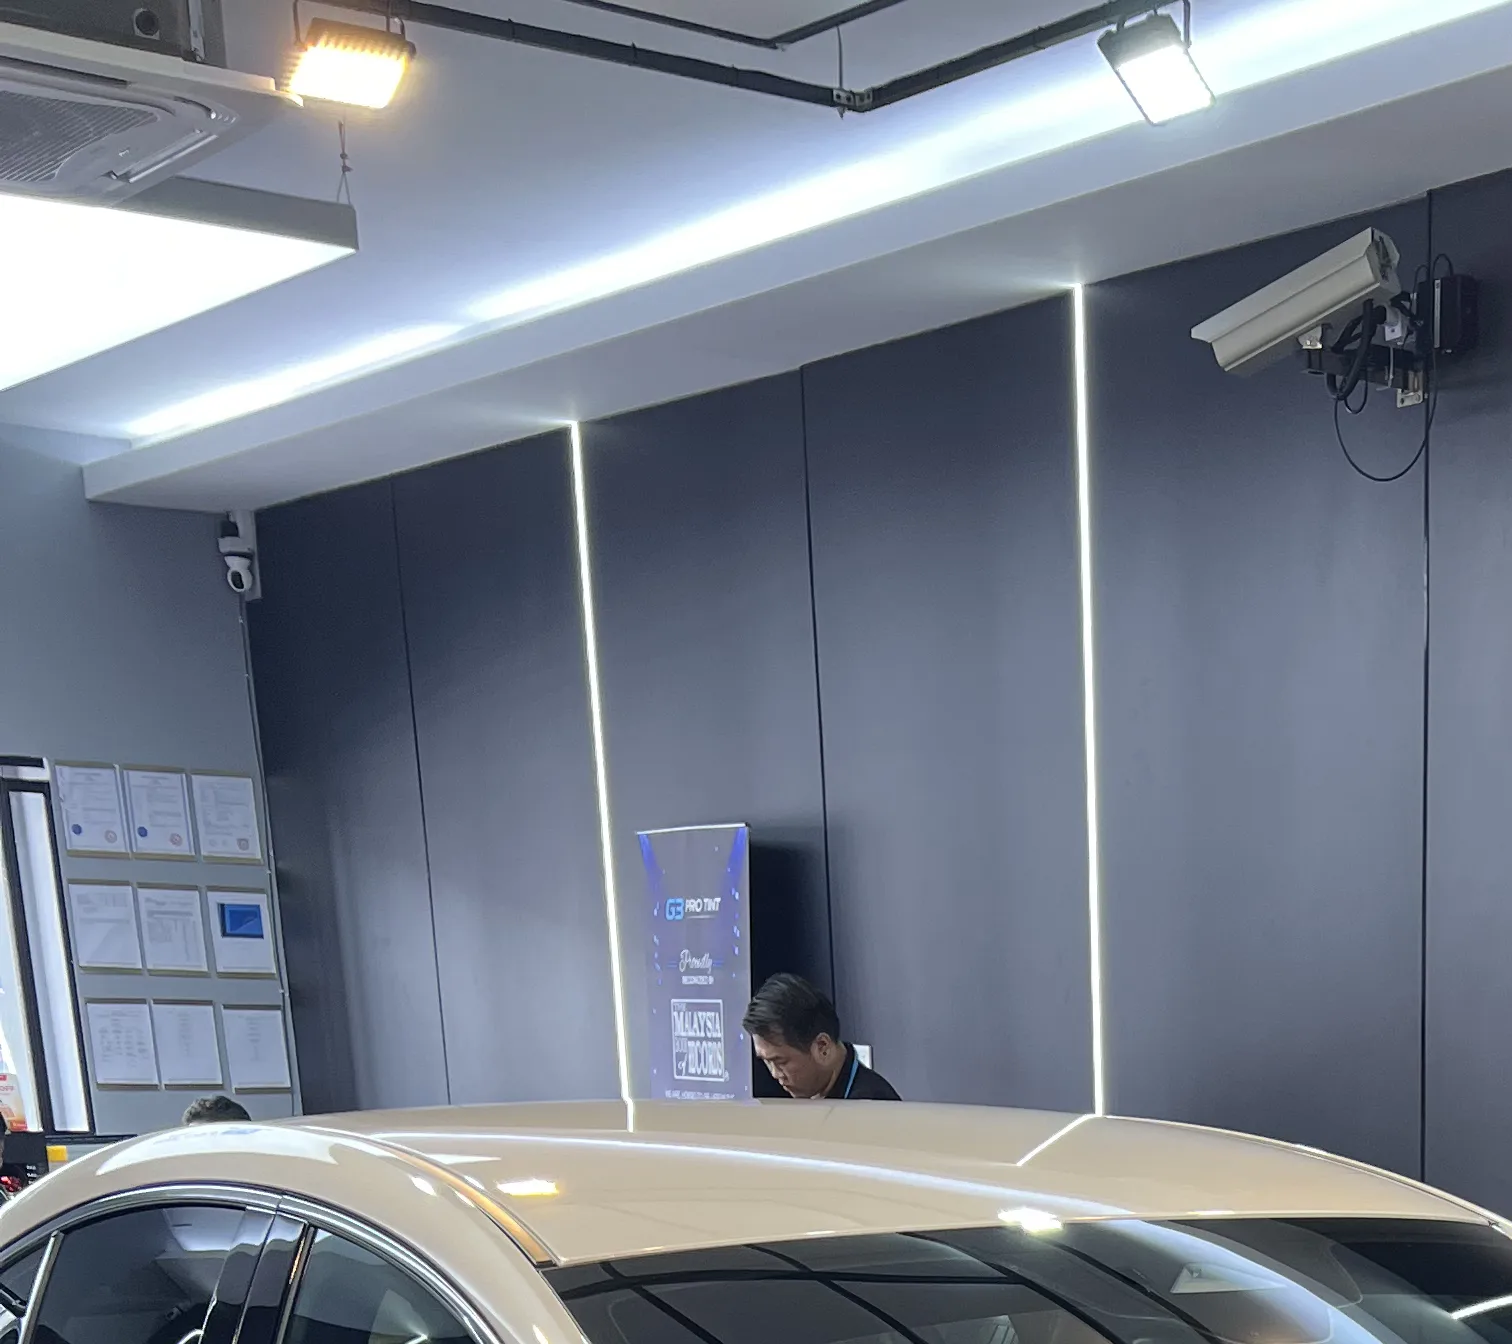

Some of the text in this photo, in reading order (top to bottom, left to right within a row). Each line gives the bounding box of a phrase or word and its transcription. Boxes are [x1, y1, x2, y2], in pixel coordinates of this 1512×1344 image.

[666, 897, 721, 920] G3 PRO TINT
[673, 1011, 721, 1037] MALAYSIA
